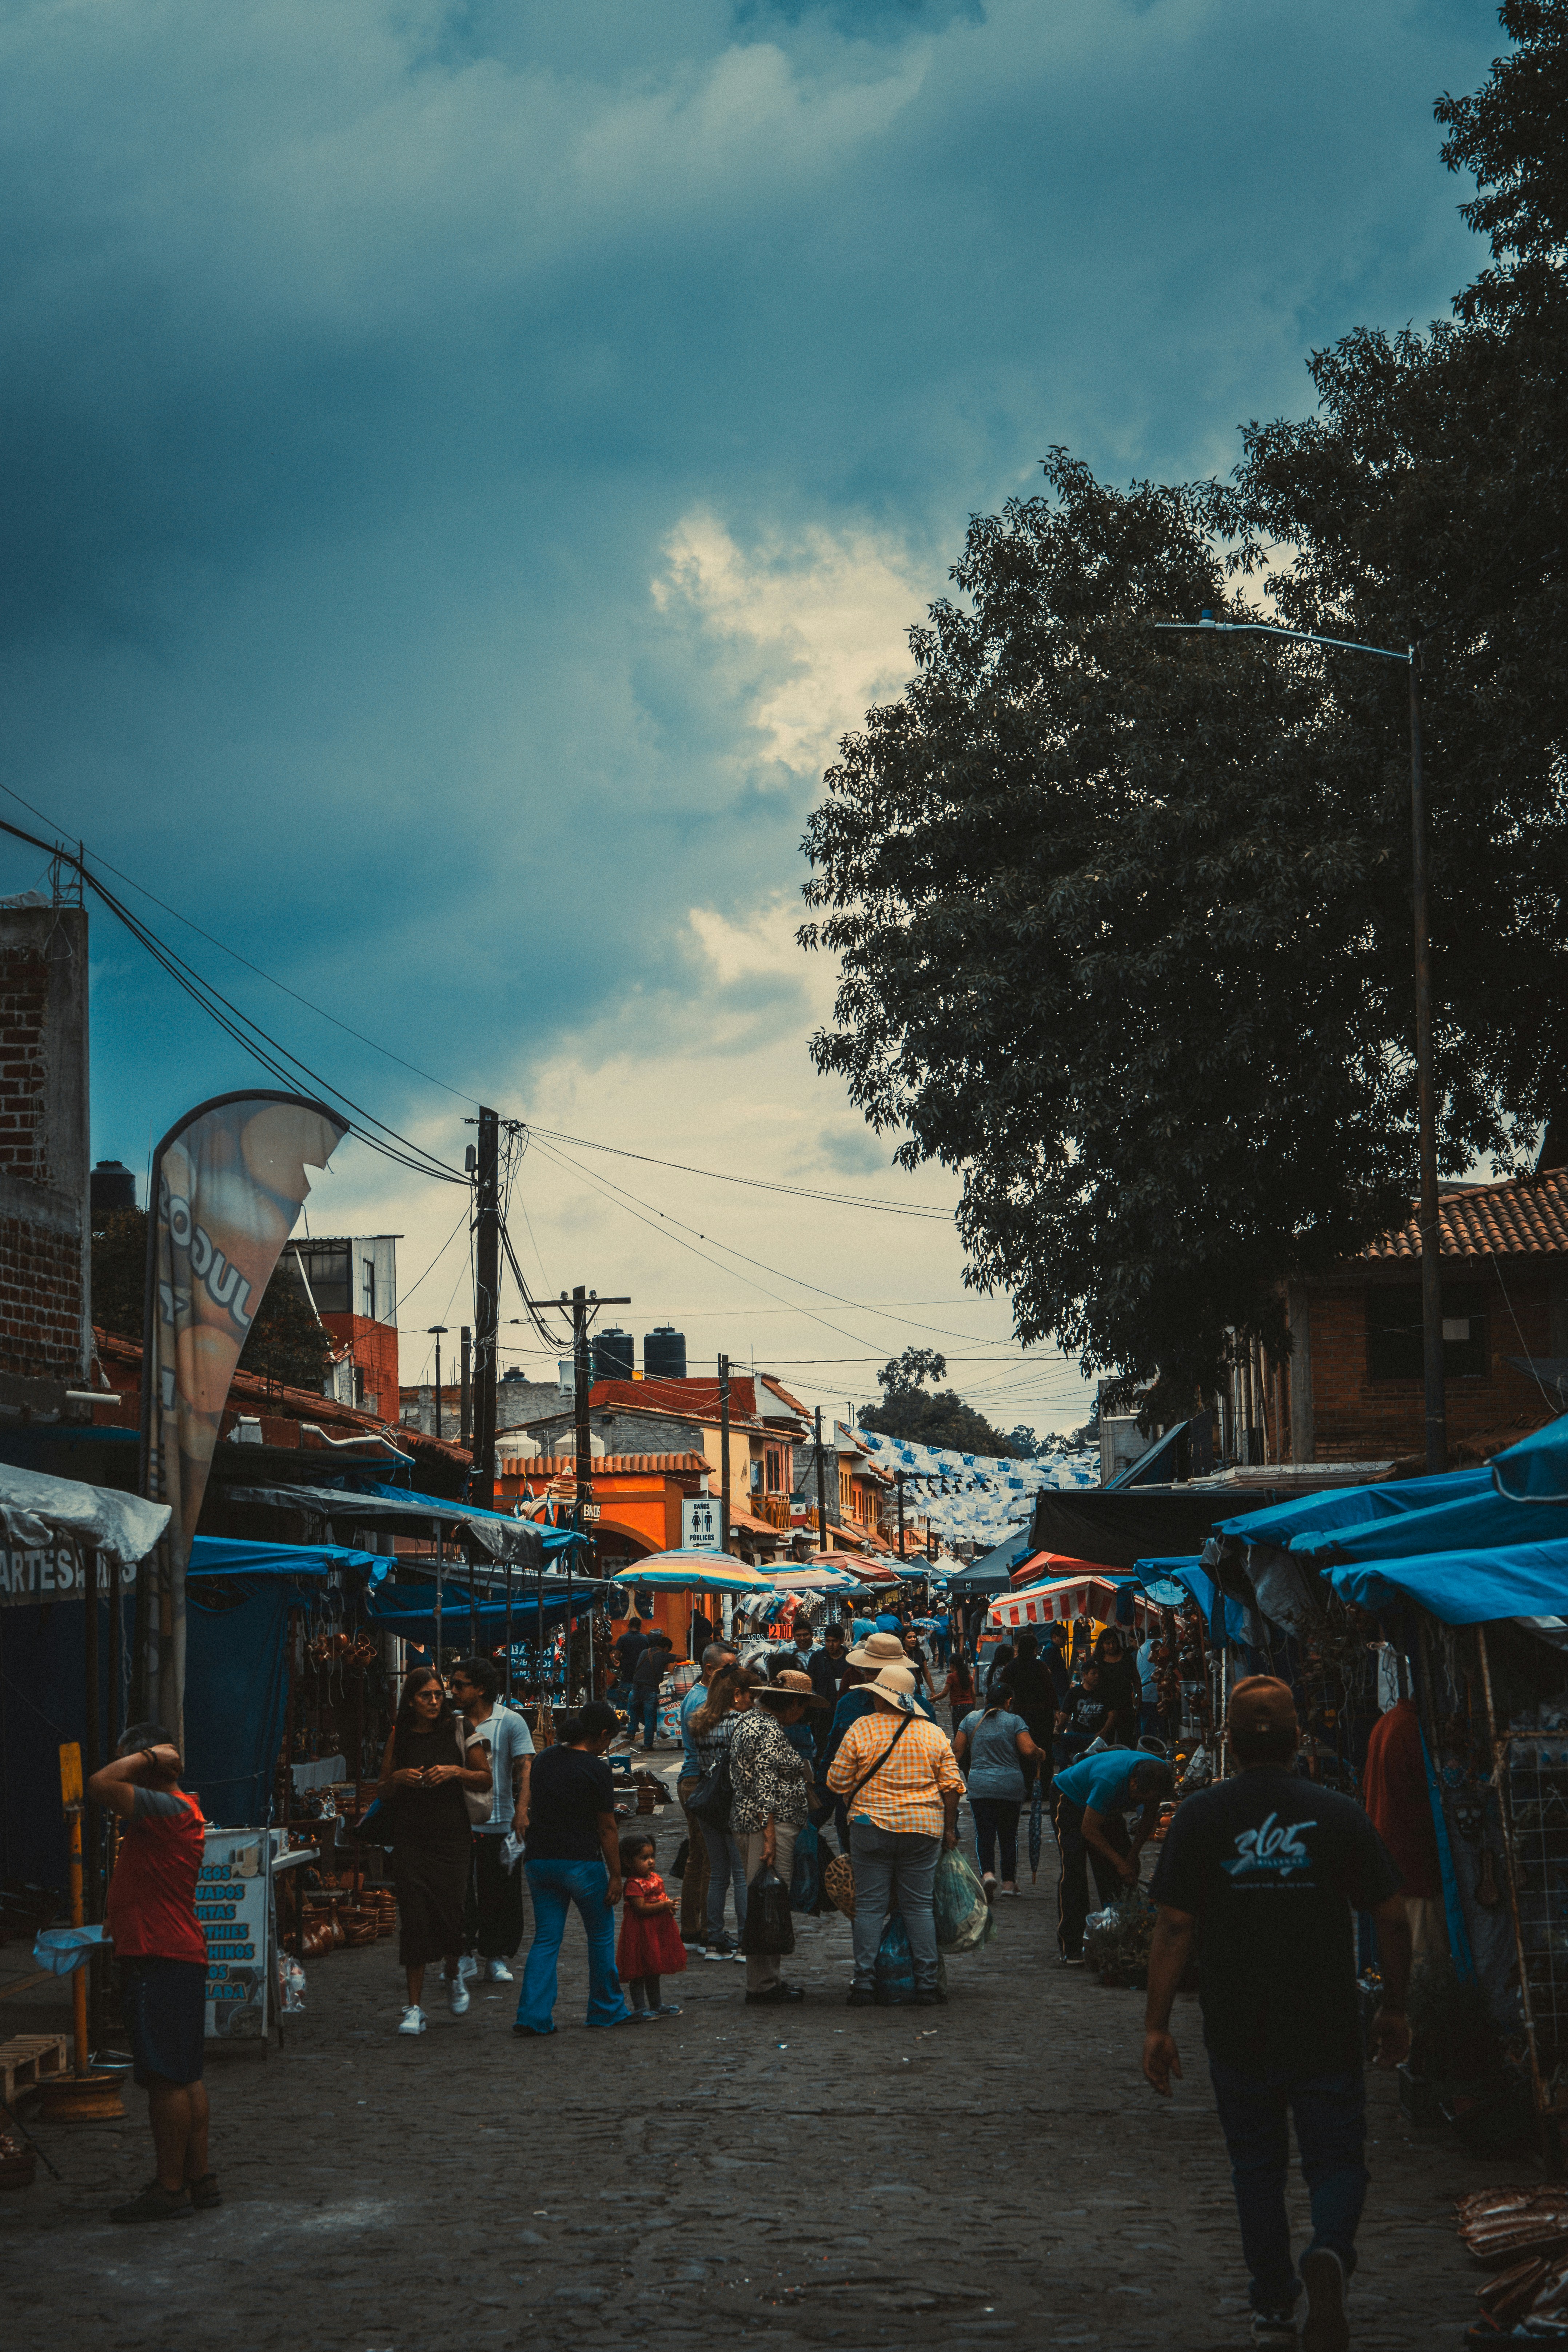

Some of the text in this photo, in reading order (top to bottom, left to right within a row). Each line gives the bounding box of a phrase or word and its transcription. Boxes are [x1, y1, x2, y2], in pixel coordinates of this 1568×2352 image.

[658, 1696, 672, 1705] RICAS
[664, 1701, 681, 1713] AGUAS
[204, 1924, 248, 1940] THIES
